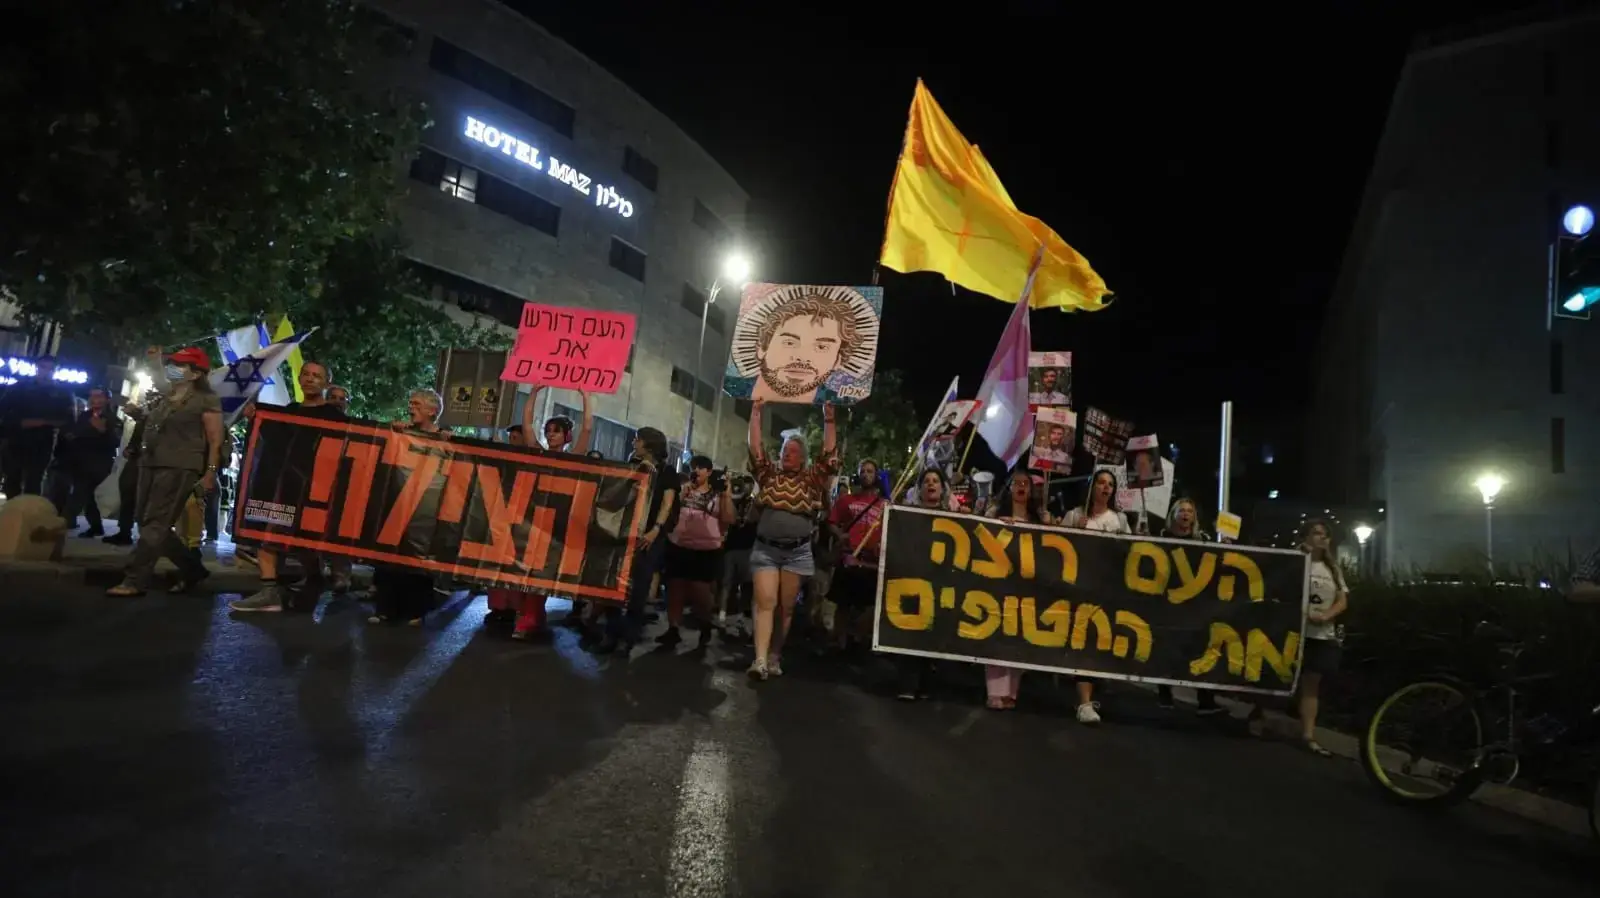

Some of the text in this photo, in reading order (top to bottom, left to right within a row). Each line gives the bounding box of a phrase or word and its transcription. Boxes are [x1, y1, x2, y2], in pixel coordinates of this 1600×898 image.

[464, 115, 592, 196] HOTEL MAZ
[595, 183, 634, 218] מלון
[524, 307, 626, 340] העם דורש
[549, 338, 590, 359] את
[515, 359, 617, 389] החטופים
[838, 384, 865, 398] אלון
[300, 436, 597, 576] הצילו!
[930, 518, 1265, 603] העם רוצה
[885, 578, 1300, 683] את החטופים
